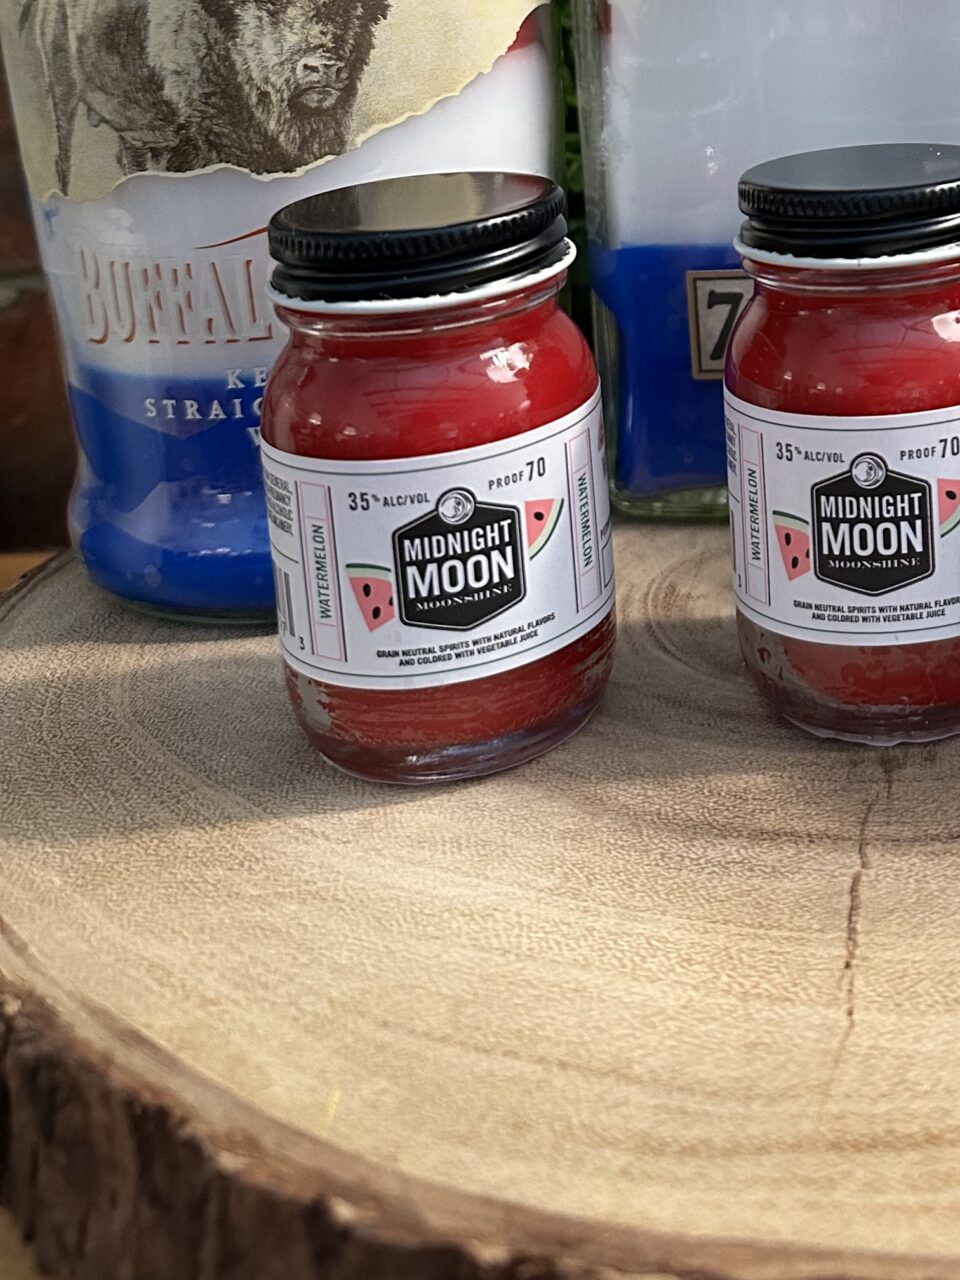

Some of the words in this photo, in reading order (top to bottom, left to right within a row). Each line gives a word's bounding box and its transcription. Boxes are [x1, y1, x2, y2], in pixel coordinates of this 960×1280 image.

[75, 246, 273, 344] BUFFAL
[706, 289, 744, 360] 7
[145, 397, 263, 419] STRAI
[803, 451, 845, 464] ALC/VOL
[900, 446, 937, 461] PROOF
[939, 436, 960, 458] 70
[488, 470, 525, 490] PROOF
[526, 457, 546, 482] 70
[382, 493, 430, 507] ALC/VOL
[747, 468, 761, 561] WATERMELON
[820, 492, 922, 519] MIDNIGHT
[577, 473, 594, 568] WATERMELON
[822, 519, 924, 556] MOON
[403, 519, 512, 562] MIDNIGHT
[312, 524, 333, 619] WATERMELON
[406, 546, 515, 600] MOON
[828, 557, 921, 570] MOONSHINE
[415, 583, 513, 612] MOONSHINE
[793, 600, 813, 609] GRAIN
[814, 603, 846, 613] NEUTRAL
[847, 605, 876, 614] SPIRITS
[878, 605, 898, 613] WITH
[899, 602, 933, 612] NATURAL
[827, 614, 859, 623] COLORED
[861, 615, 881, 623] WITH
[882, 610, 924, 622] VEGETABLE
[925, 608, 946, 618] JUICE
[377, 650, 400, 658] GRAIN
[402, 646, 436, 657] NEUTRAL
[439, 641, 470, 653] SPIRITS
[472, 634, 492, 646] WITH
[493, 626, 526, 641] NATURAL
[527, 612, 556, 629] FLAVORS
[399, 658, 415, 666] AND
[417, 653, 452, 665] COLORED
[454, 649, 472, 660] WITH
[472, 637, 518, 655] VEGETABLE
[519, 629, 539, 643] JUICE
